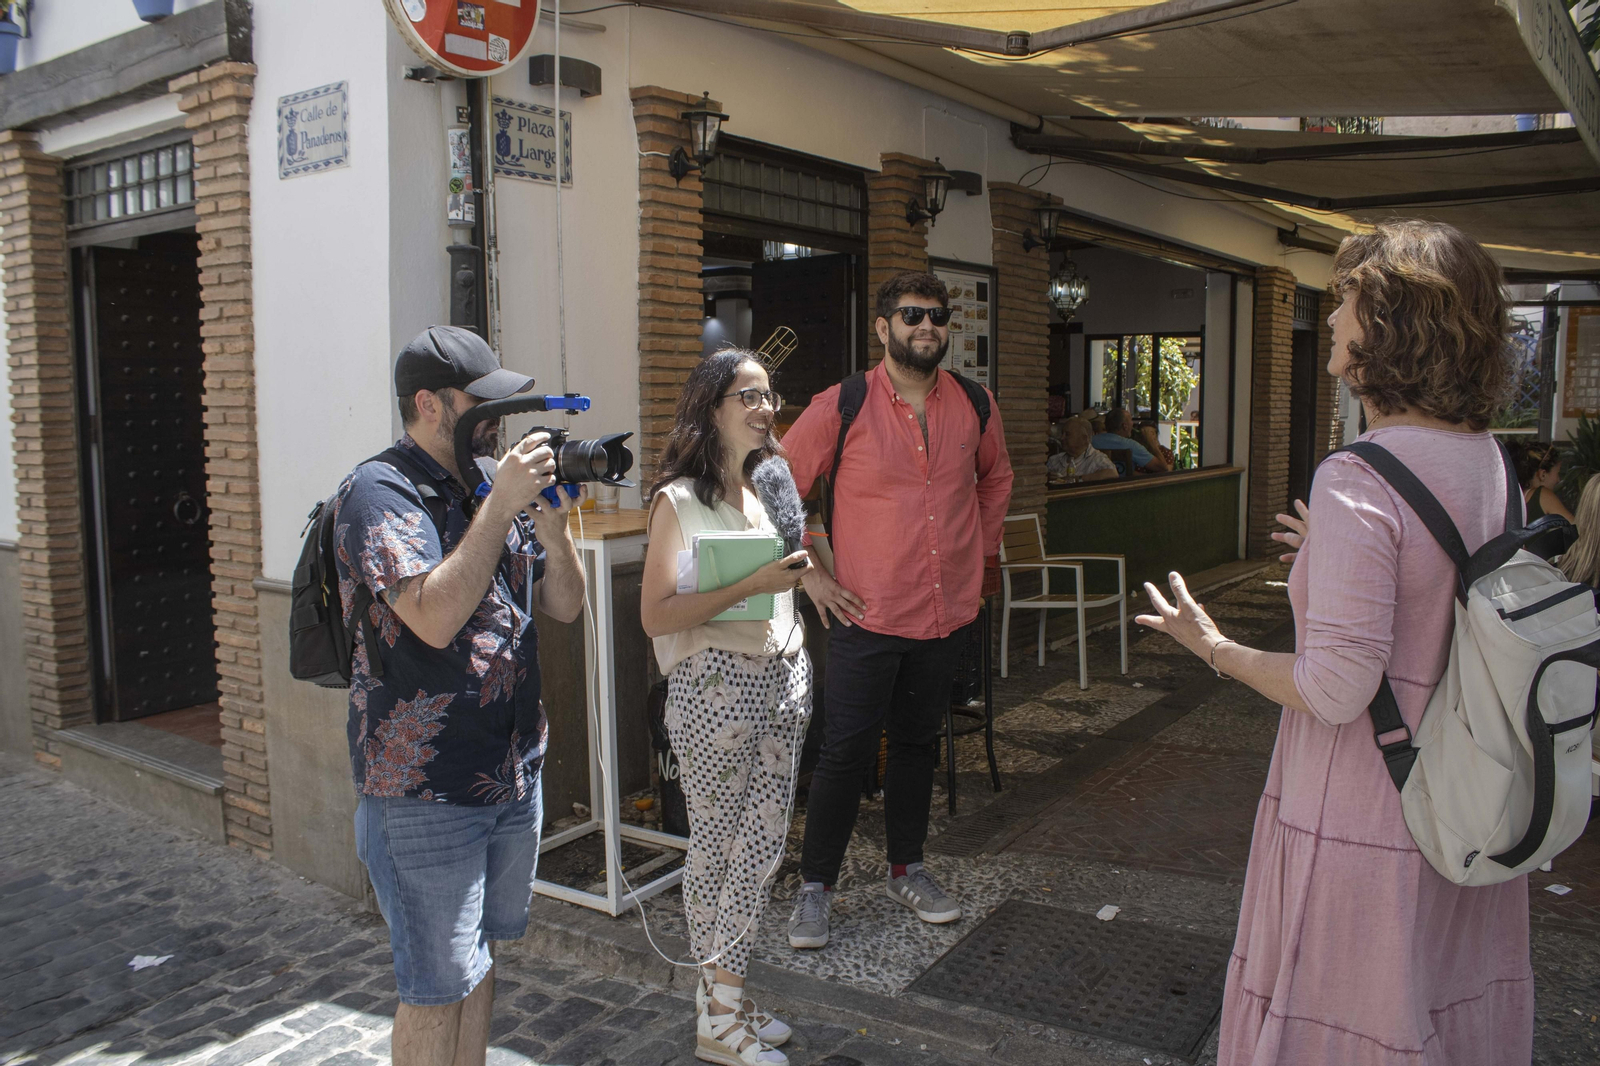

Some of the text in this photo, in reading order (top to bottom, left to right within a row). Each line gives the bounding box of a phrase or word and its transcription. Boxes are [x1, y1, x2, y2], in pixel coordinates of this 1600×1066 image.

[300, 100, 338, 122] Calle de
[300, 125, 342, 150] Panaderos
[517, 116, 556, 138] Plaza
